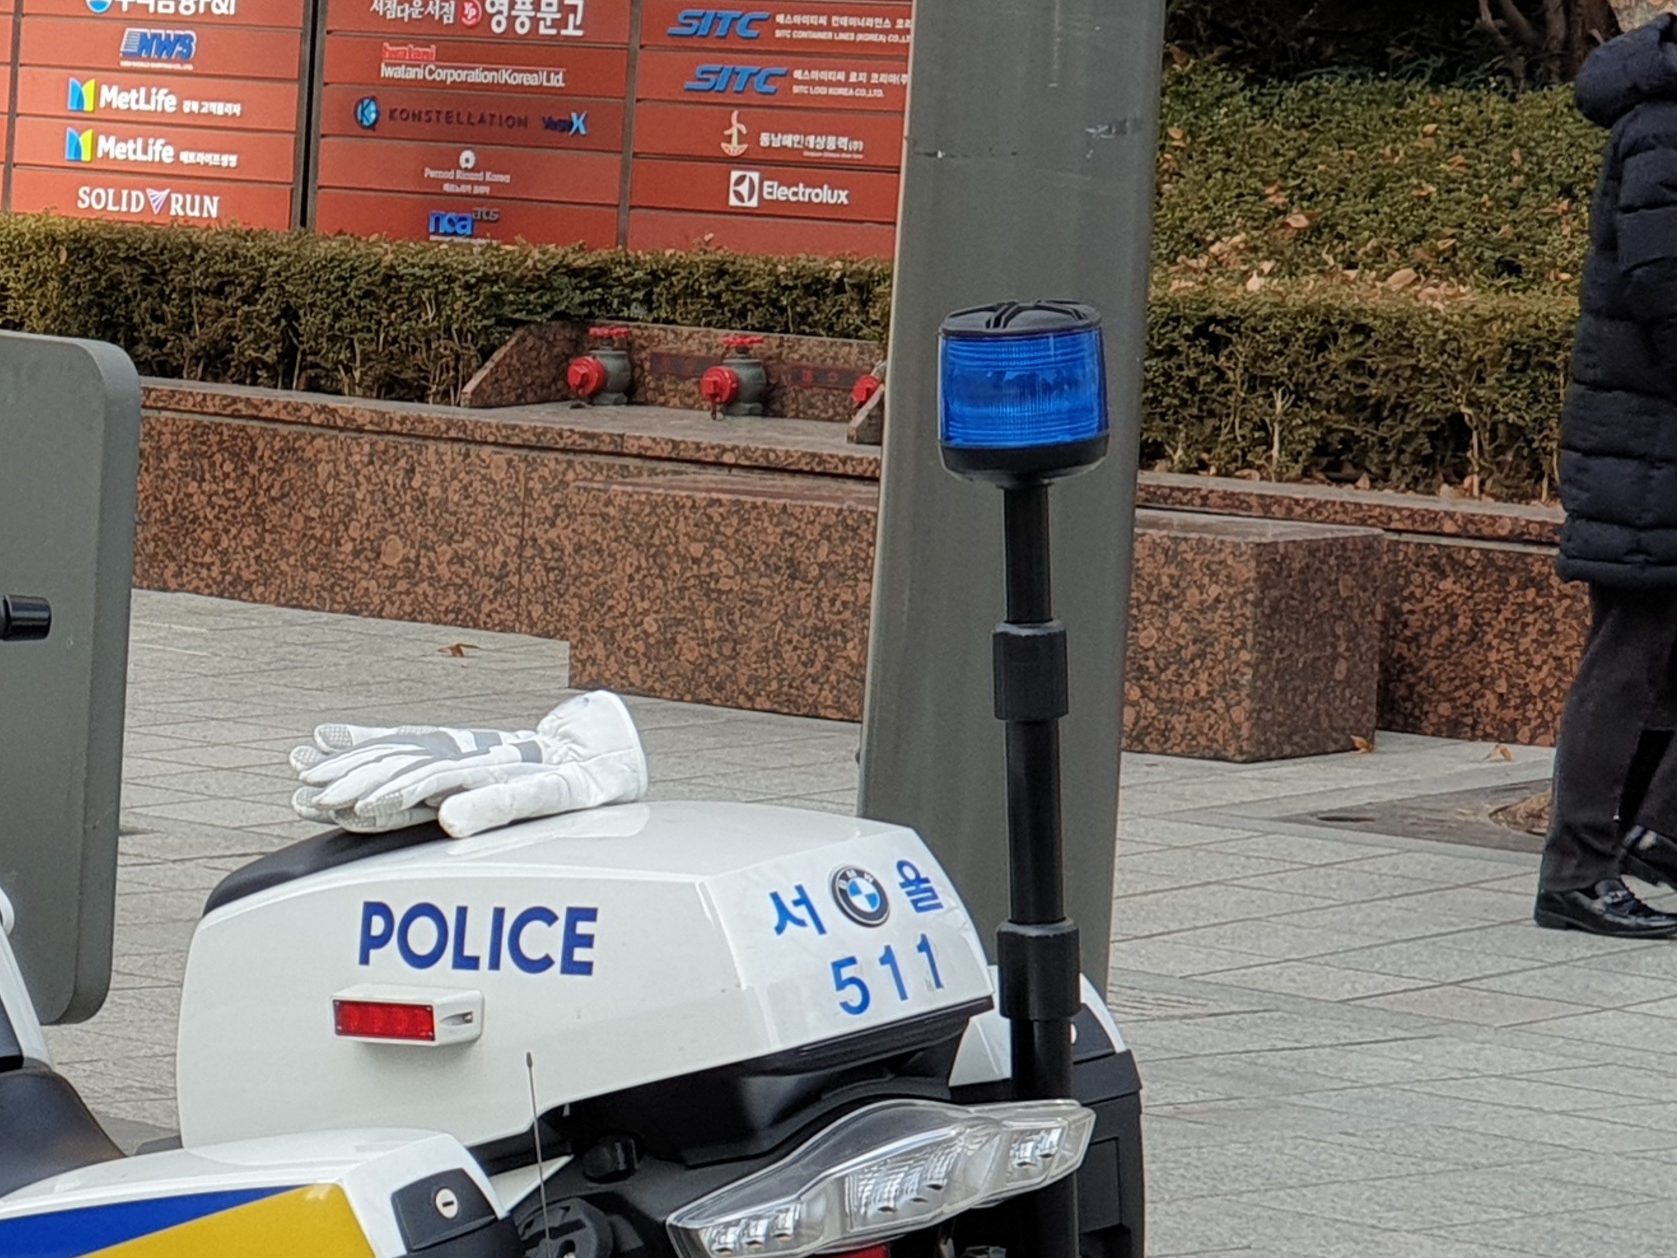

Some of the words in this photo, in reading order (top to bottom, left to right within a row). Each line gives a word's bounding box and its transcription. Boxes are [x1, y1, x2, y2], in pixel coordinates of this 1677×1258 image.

[485, 0, 585, 36] 영풍문고
[667, 9, 770, 38] SITC
[775, 13, 827, 27] 에스아이티씨
[129, 29, 197, 60] NWS
[775, 29, 792, 39] SITC
[792, 30, 833, 41] CONTAINER
[834, 31, 856, 42] LINES
[856, 32, 886, 43] (KOREA)
[380, 62, 423, 80] Iwatani
[684, 63, 788, 93] SITC
[793, 69, 845, 83] 에스아이티씨
[99, 84, 177, 113] MetLife
[792, 85, 809, 95] SITC
[828, 86, 854, 96] KOREA
[388, 107, 529, 129] KONSTELLATION
[97, 135, 175, 164] MetLife
[77, 186, 146, 213] SOLID
[169, 193, 220, 218] RUN
[762, 180, 849, 205] Electrolux
[357, 900, 598, 976] POLICE
[830, 933, 945, 1015] 511
